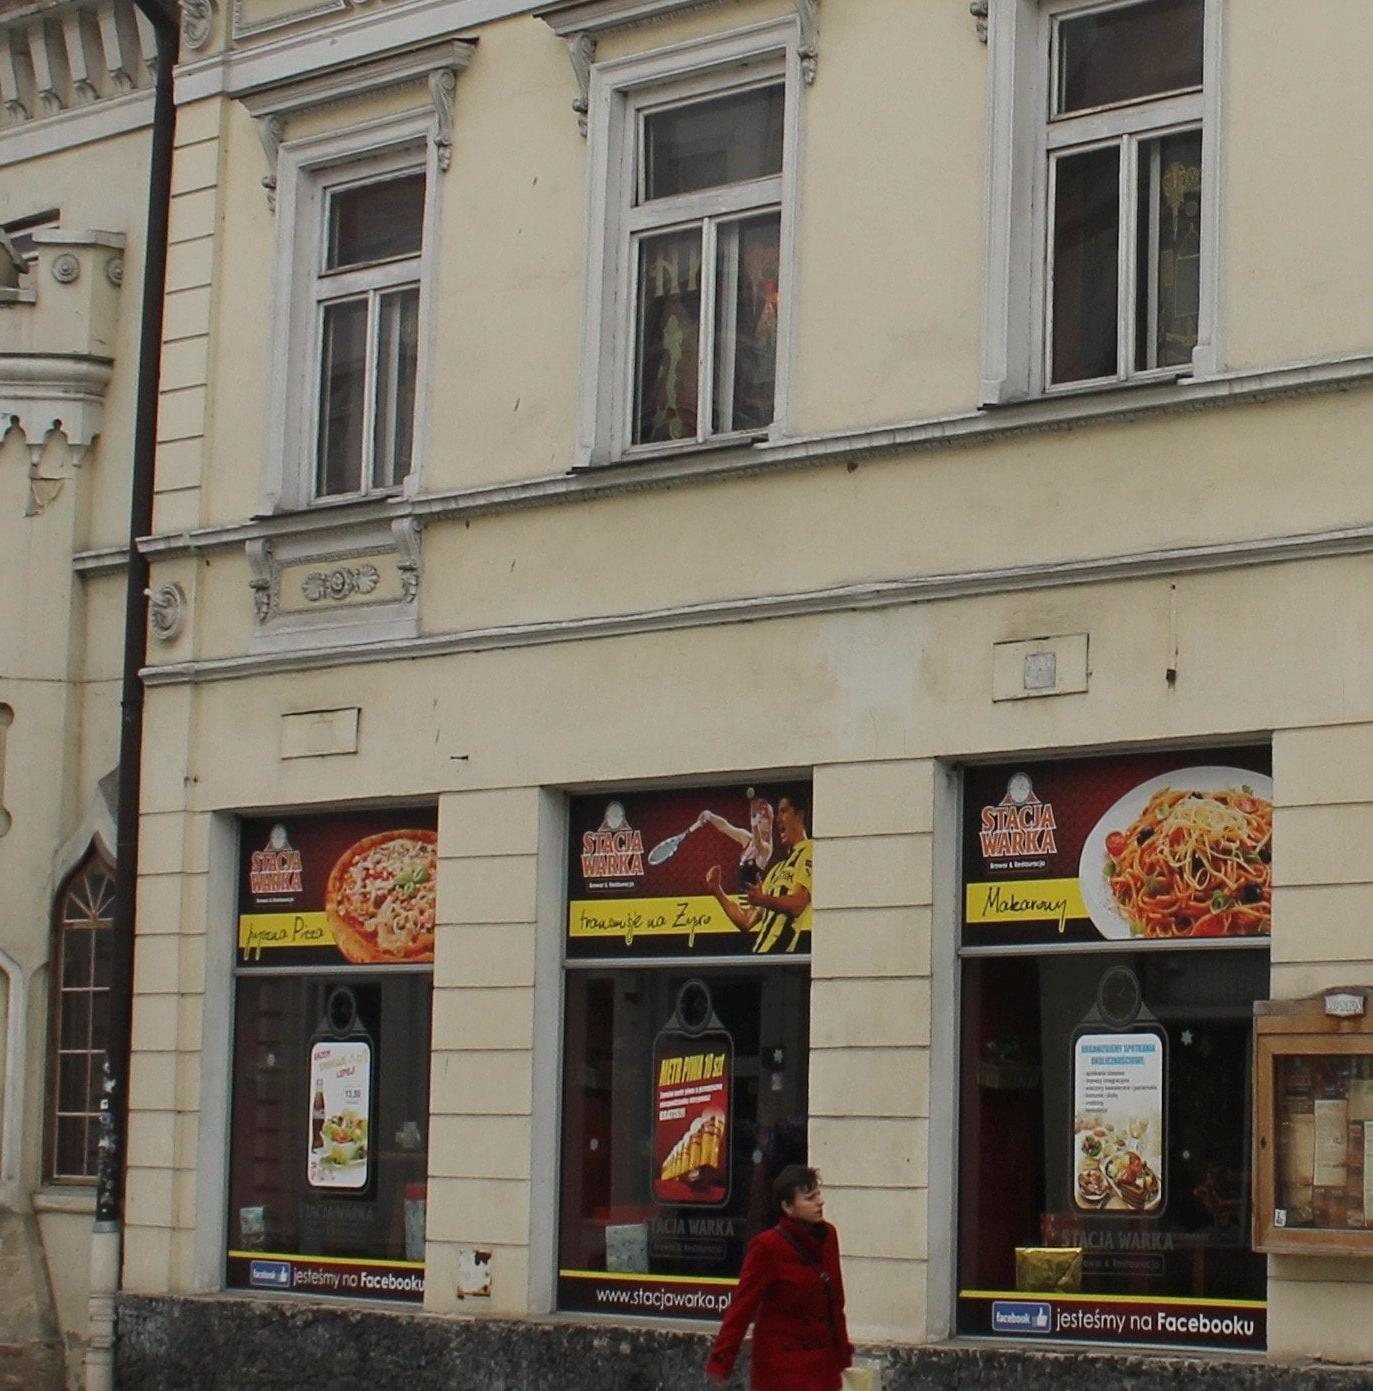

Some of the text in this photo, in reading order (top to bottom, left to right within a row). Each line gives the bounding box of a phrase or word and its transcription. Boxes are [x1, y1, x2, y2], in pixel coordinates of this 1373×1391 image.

[980, 803, 1059, 832] STACJA
[582, 829, 644, 856] STACJA
[979, 829, 1059, 858] WARKA
[251, 849, 303, 873] STACJA
[581, 852, 645, 877] WARKA
[250, 871, 303, 893] WARKA
[647, 916, 667, 929] na
[983, 886, 1067, 934] Makarony
[292, 916, 324, 942] Pizza
[1117, 1231, 1175, 1251] WARKA
[293, 1268, 339, 1287] jesteśmy
[342, 1274, 357, 1286] na
[596, 1288, 732, 1312] www.stacjawarka.pl
[996, 1308, 1255, 1336] facebook jesteśmy na Facebooku
